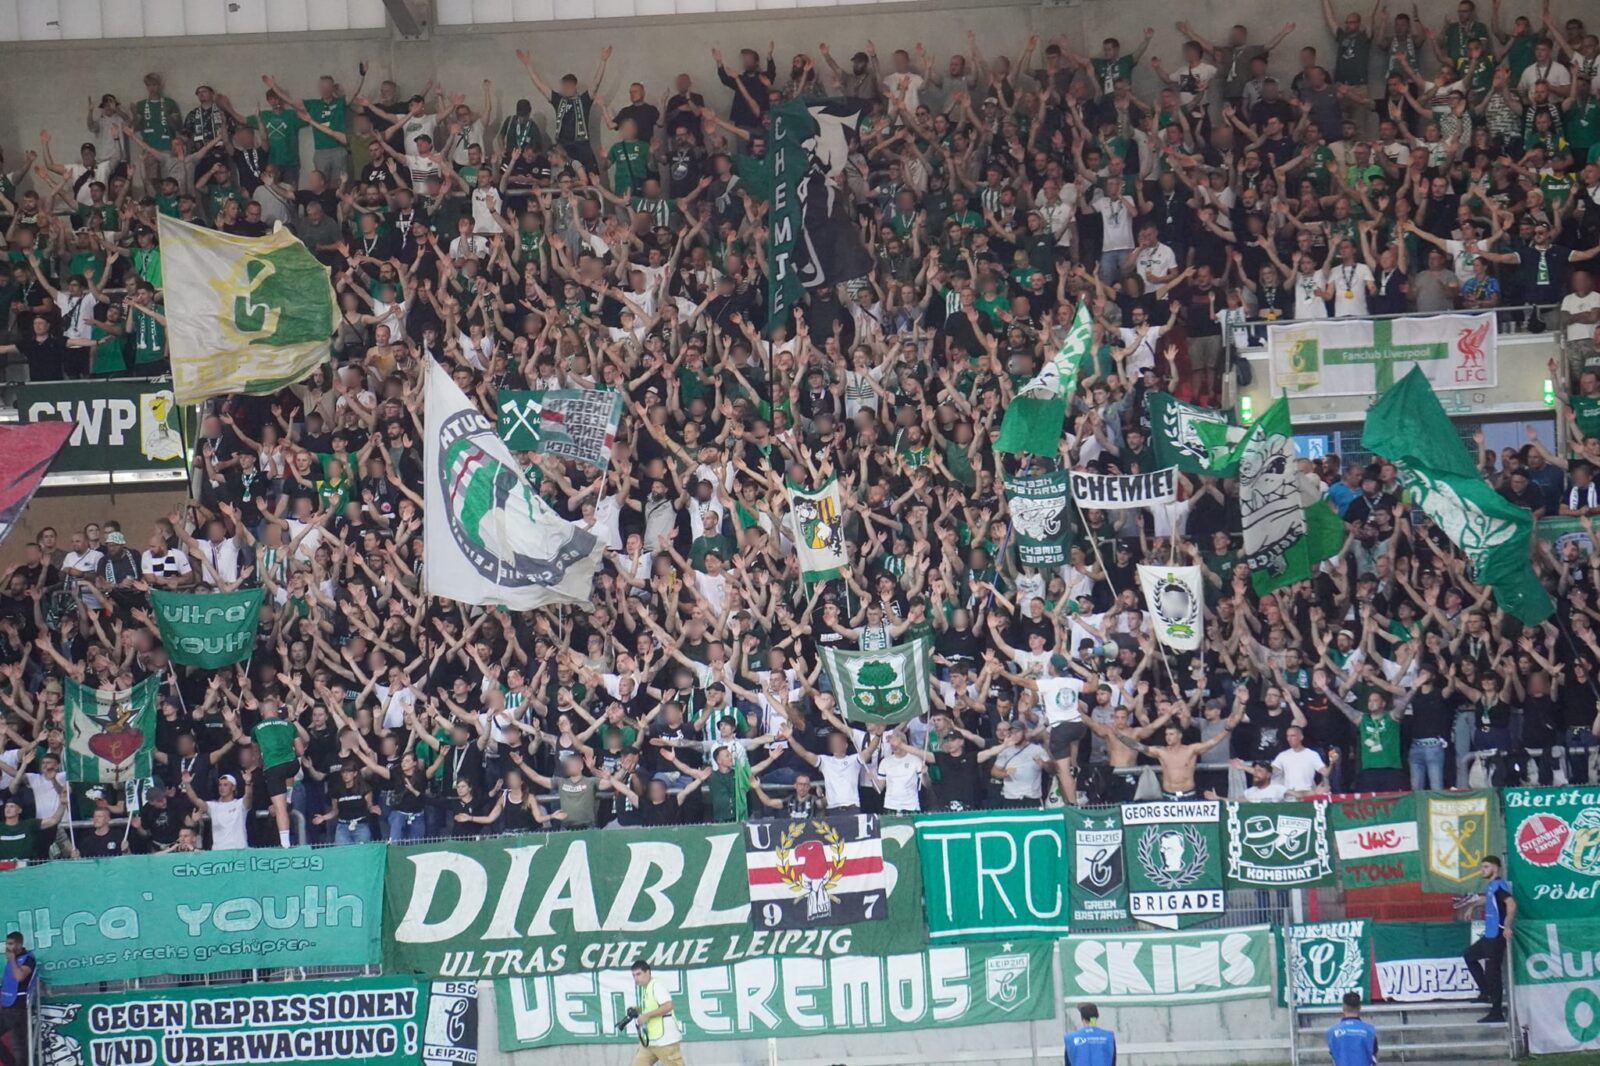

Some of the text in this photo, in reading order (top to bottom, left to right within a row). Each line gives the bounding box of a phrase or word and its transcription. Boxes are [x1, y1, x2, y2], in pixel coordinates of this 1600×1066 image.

[774, 115, 792, 314] CHEMIE
[1343, 348, 1431, 361] Fanclub Liverpool
[1073, 472, 1175, 502] CHEMIE!
[1125, 804, 1217, 820] GEORG SCHWARZ
[747, 814, 879, 849] U F
[1078, 833, 1120, 843] LEIPZIG
[923, 829, 1062, 922] TRC
[1246, 867, 1312, 881] KOMBINAT
[763, 895, 879, 927] 9 7
[1133, 893, 1221, 911] BRIGADE
[440, 928, 852, 977] ULTRAS CHEMIE LEIPZIG
[1074, 933, 1255, 994] SKINS
[445, 982, 477, 995] BSG
[1381, 963, 1480, 994] WURZE
[90, 989, 417, 1033] GEGEN REPRESSIONEN
[91, 1037, 156, 1066] UND
[162, 1028, 397, 1064] ÜBERWACHUNG
[427, 1048, 477, 1063] LEIPZIG
